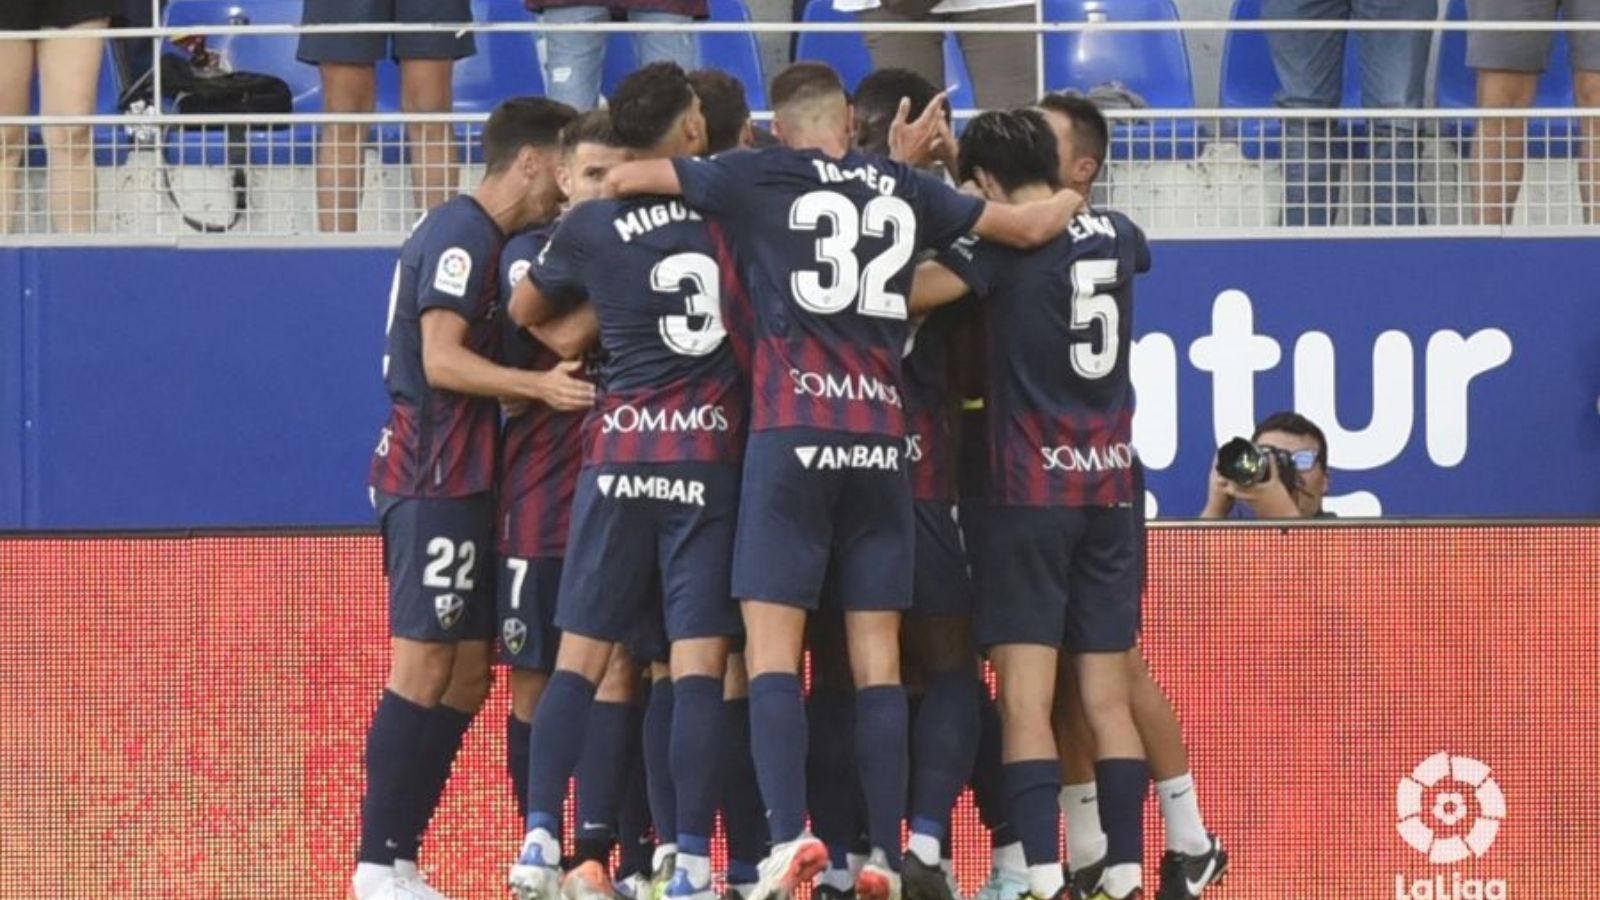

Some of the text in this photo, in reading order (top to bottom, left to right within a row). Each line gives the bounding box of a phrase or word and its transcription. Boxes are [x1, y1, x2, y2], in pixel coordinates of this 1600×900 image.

[613, 201, 703, 243] MIGU
[788, 190, 917, 321] 32
[650, 252, 728, 356] 3
[1070, 259, 1119, 379] 5
[790, 368, 902, 408] SOMMO
[601, 404, 728, 434] SOMMOS
[1041, 442, 1134, 471] SOMMO
[614, 475, 705, 506] AMBAR
[422, 536, 476, 590] 22
[506, 557, 528, 610] 7
